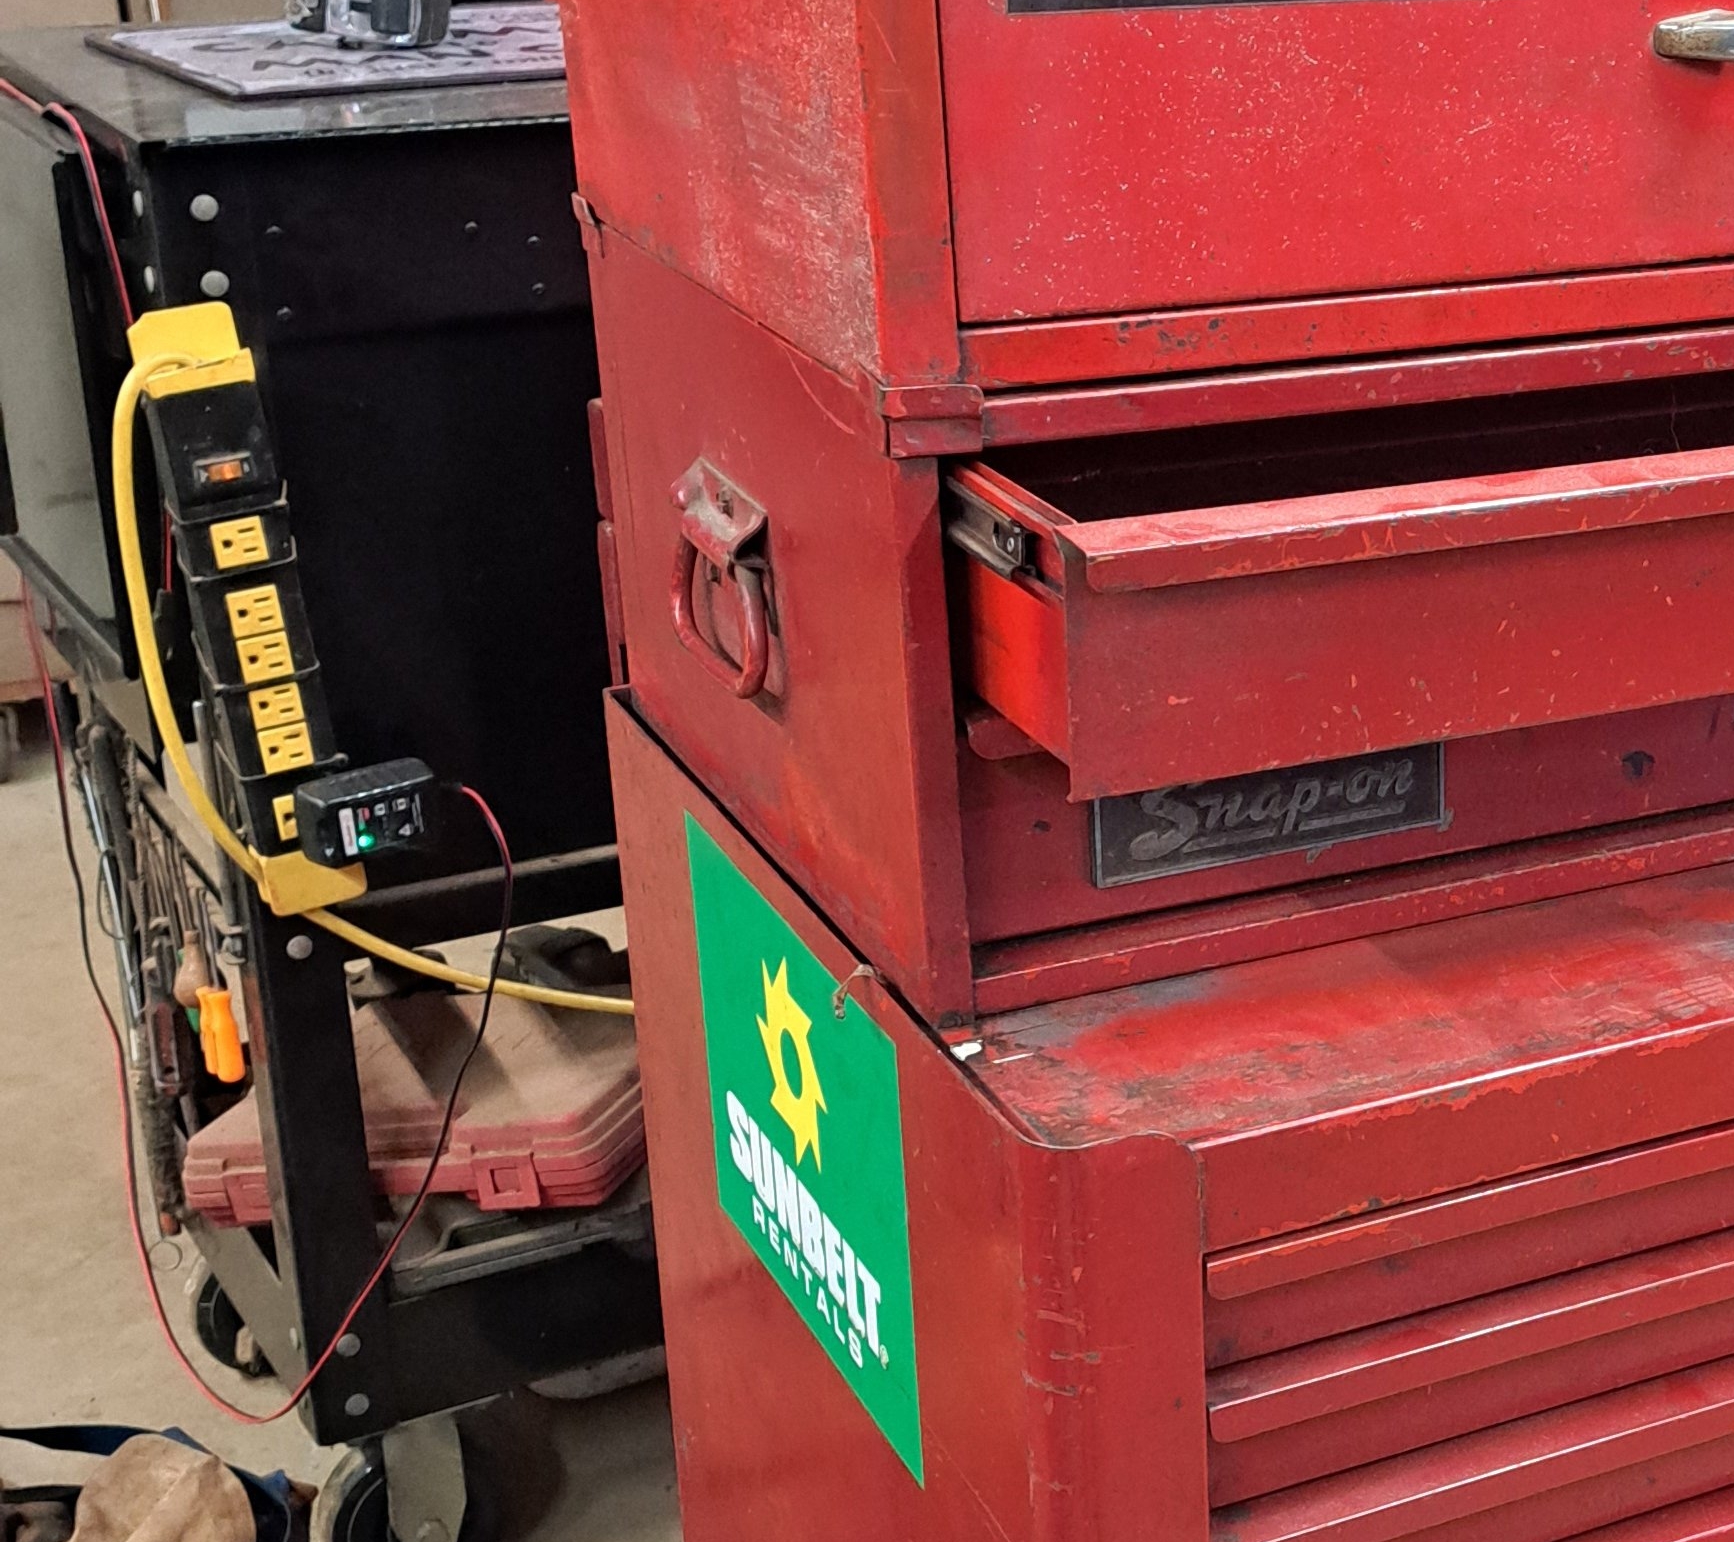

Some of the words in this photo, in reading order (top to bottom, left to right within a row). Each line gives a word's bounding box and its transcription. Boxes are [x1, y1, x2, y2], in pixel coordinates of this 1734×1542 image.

[1129, 758, 1416, 860] Snap-on
[726, 1090, 881, 1359] SUNBELT
[752, 1194, 863, 1370] RENTALS
